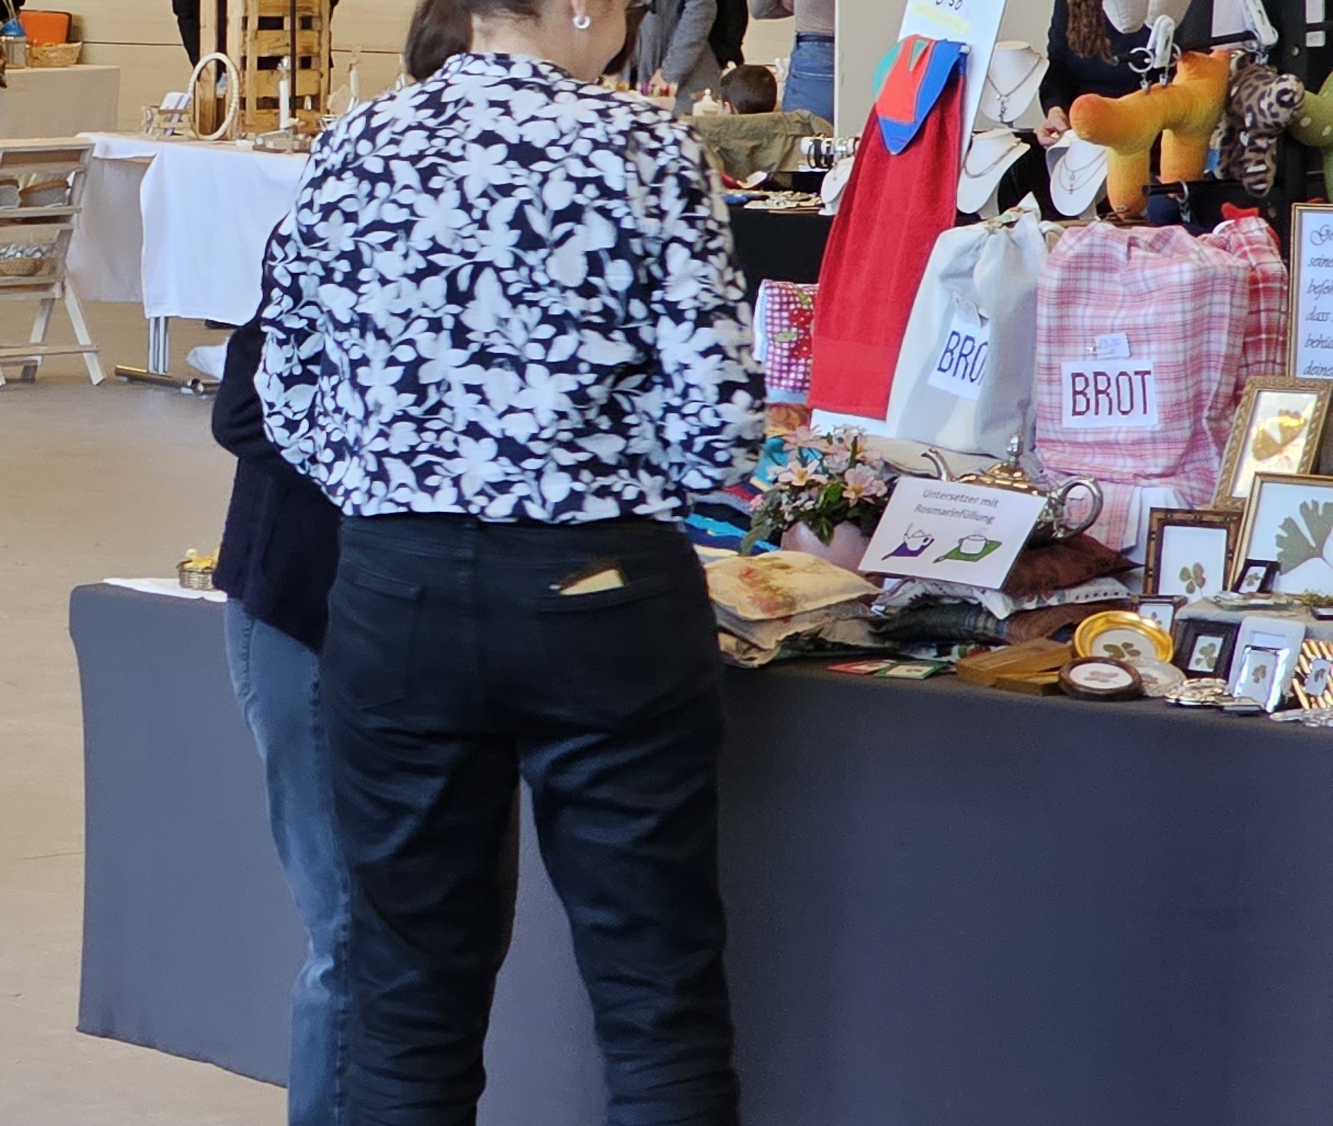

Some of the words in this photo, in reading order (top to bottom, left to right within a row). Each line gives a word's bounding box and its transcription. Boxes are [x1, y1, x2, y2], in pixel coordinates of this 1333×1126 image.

[937, 330, 988, 385] BRO
[1071, 370, 1152, 417] BROT
[914, 503, 996, 525] Rosmarinfüllung
[922, 488, 979, 505] Untersetzer
[980, 497, 999, 508] mit
